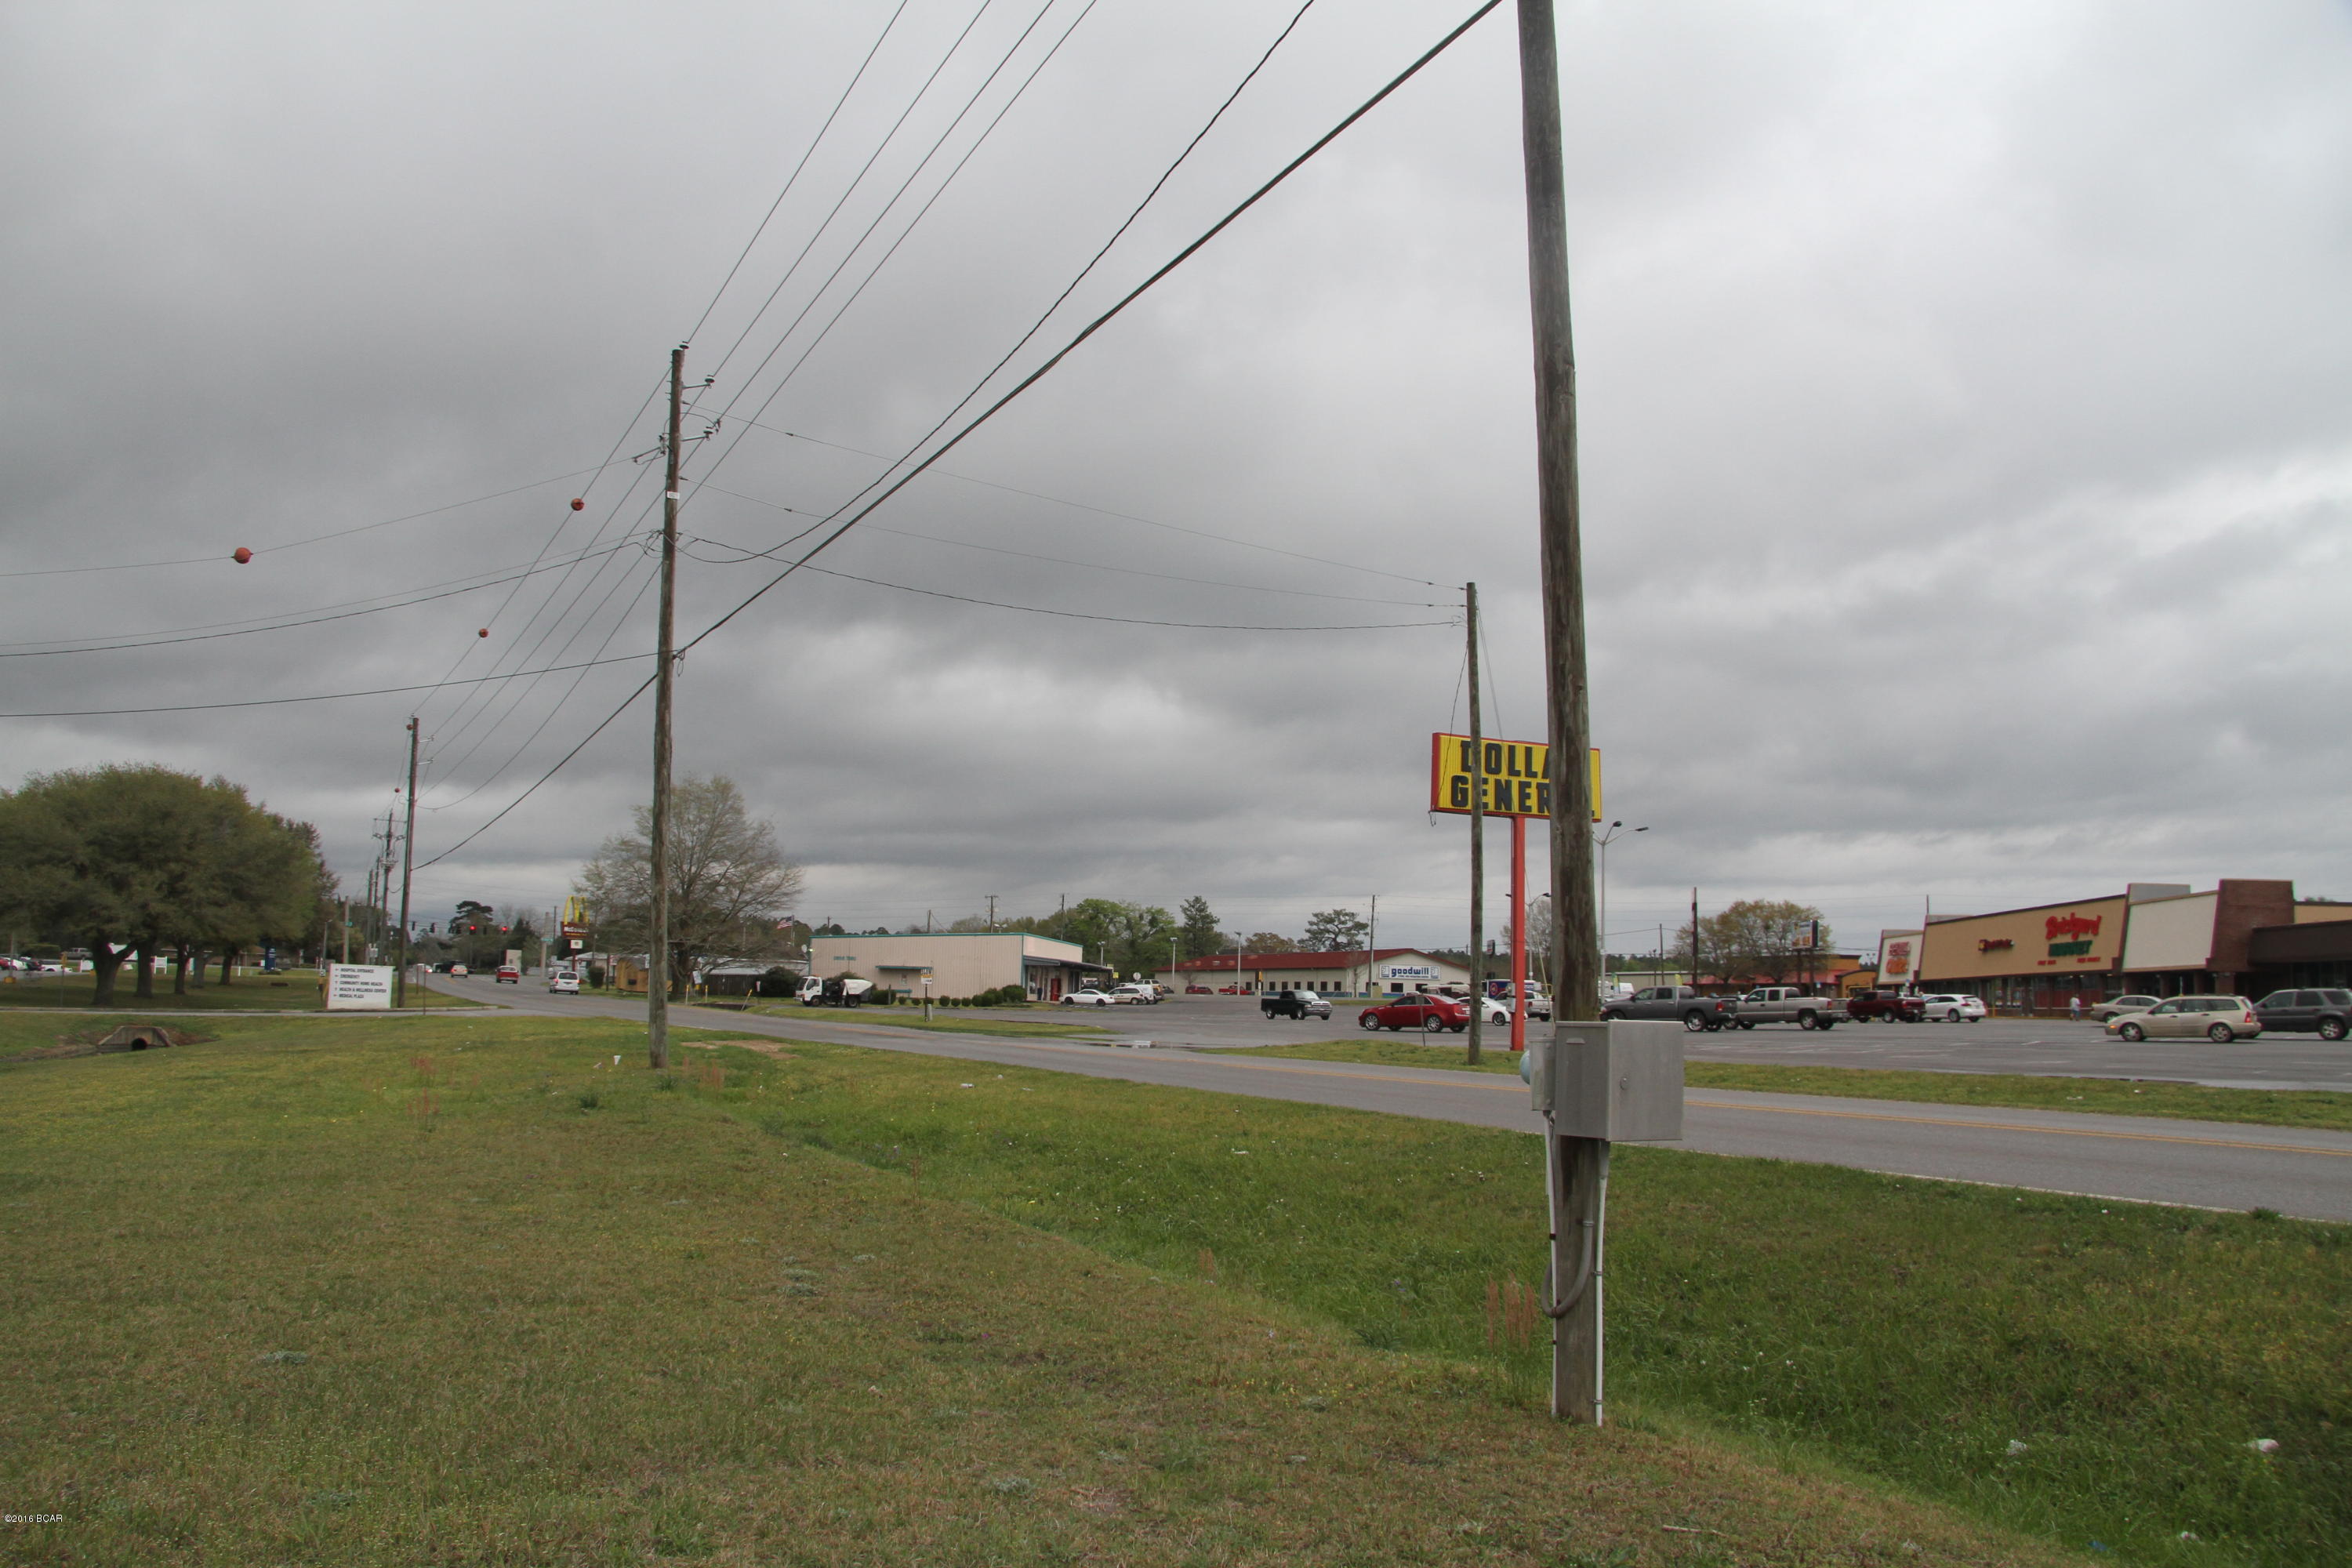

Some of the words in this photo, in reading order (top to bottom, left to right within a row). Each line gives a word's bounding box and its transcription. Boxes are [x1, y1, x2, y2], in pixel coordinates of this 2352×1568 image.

[1460, 740, 1551, 779] DOLL
[1450, 775, 1595, 817] GNER
[1391, 966, 1429, 978] goodwill
